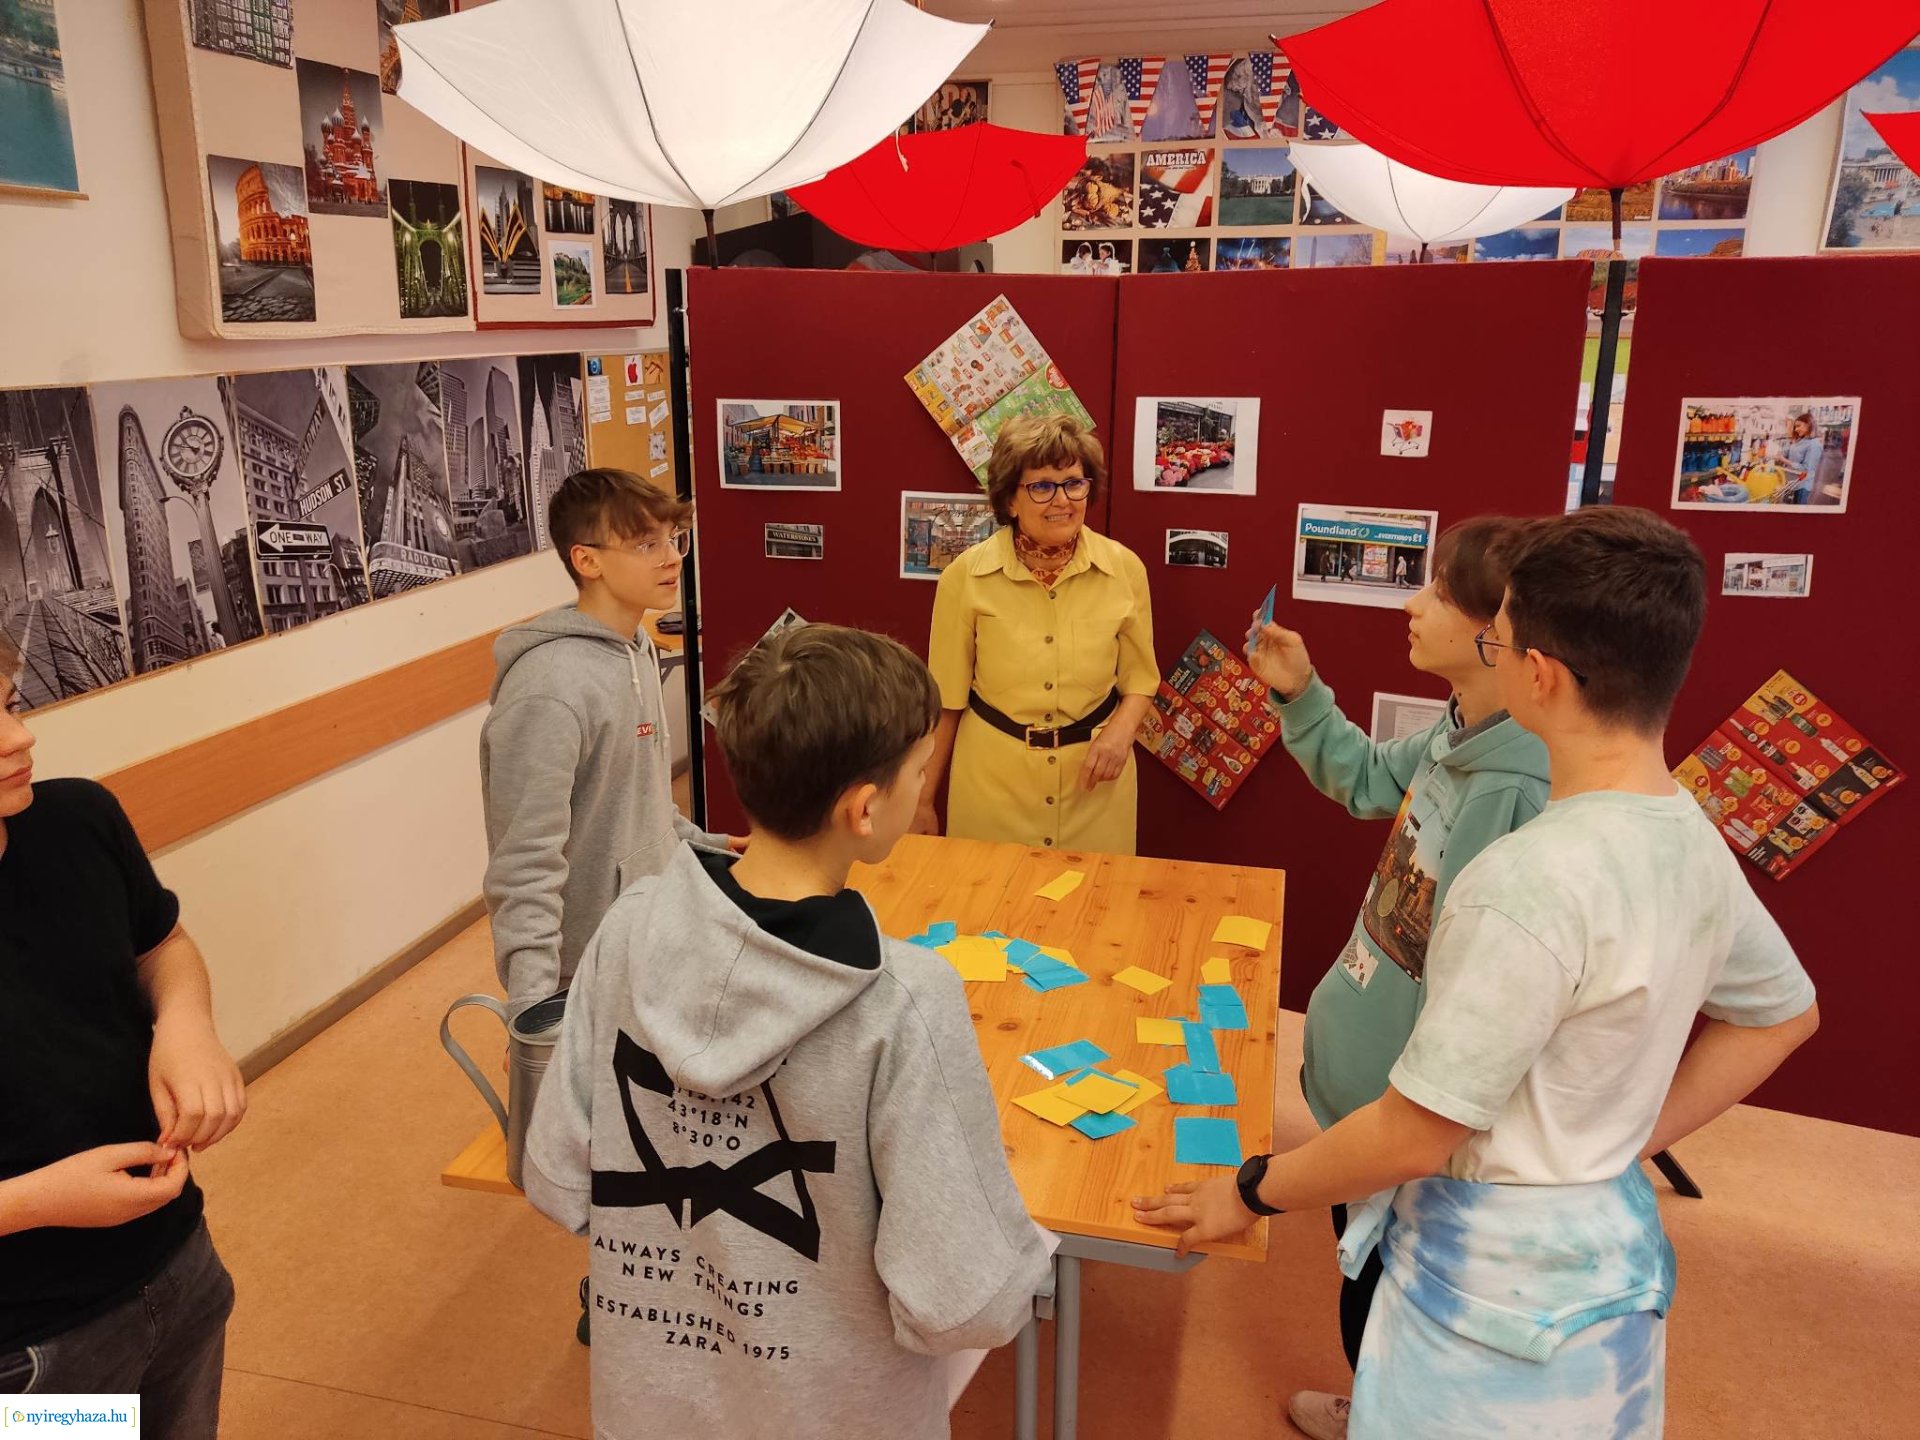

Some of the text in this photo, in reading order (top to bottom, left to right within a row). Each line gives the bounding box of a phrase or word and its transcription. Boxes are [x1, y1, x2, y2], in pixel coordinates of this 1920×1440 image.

[1146, 151, 1206, 167] AMERICA
[299, 473, 348, 516] HUDSON ST
[269, 531, 324, 544] ONE WAY
[1305, 522, 1358, 537] Poundland
[401, 549, 429, 565] RADIO
[594, 1234, 798, 1296] ALWAYS CREATING
[622, 1262, 764, 1318] NEW THINGS
[596, 1294, 790, 1360] ESTABLISHED 1975
[665, 1330, 722, 1355] ZARA
